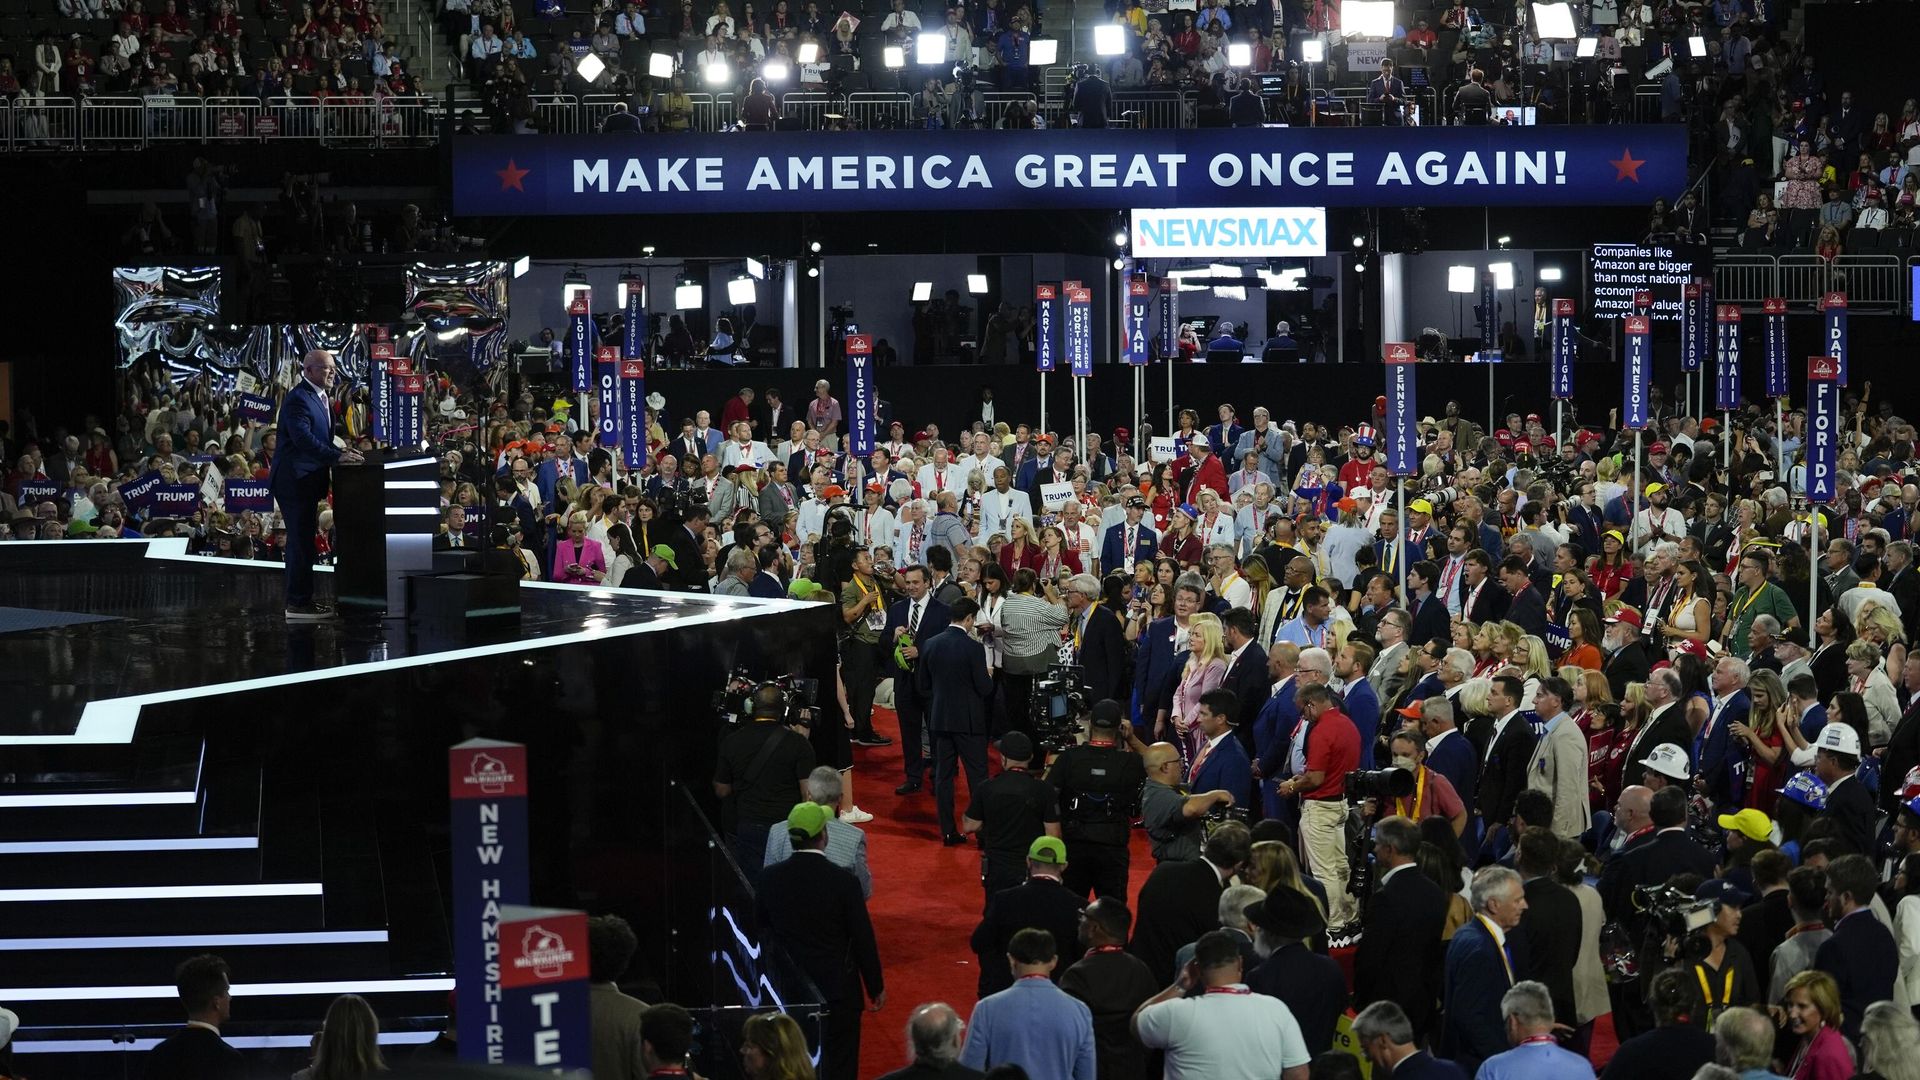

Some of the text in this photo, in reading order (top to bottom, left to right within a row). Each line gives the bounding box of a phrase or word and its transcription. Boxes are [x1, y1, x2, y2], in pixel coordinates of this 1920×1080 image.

[574, 152, 1566, 193] MAKE AMERICA GREAT ONCE AGAIN!
[1139, 218, 1318, 246] NEWSMAX
[1594, 247, 1672, 258] Companies like
[1594, 260, 1692, 273] Amazon are bigger
[1594, 272, 1691, 284] than most national
[576, 317, 586, 388] LOUISIANA
[1042, 301, 1050, 367] MARYLAND
[1074, 308, 1082, 368] NORTHERN
[1133, 305, 1144, 353] UTAH
[1561, 318, 1569, 392] MICHIGAN
[1728, 325, 1738, 403] HAWAII
[378, 361, 388, 436] MISSOURI
[629, 380, 637, 411] NORTH
[1631, 336, 1642, 423] MINNESOTA
[243, 399, 271, 412] TRUMP
[601, 375, 614, 433] OHIO
[853, 357, 867, 451] WISCONSIN
[1396, 366, 1406, 469] PENNSYLVANIA
[1814, 383, 1829, 494] FLORIDA
[22, 487, 57, 496] TRUMP
[124, 478, 161, 500] TRUMP
[155, 492, 195, 502] TRUMP
[229, 487, 269, 498] TRUMP
[1044, 491, 1073, 501] TRUMP
[1546, 632, 1573, 649] UMP
[477, 803, 504, 1065] NEW HAMPSHIRE
[531, 991, 563, 1075] TE
